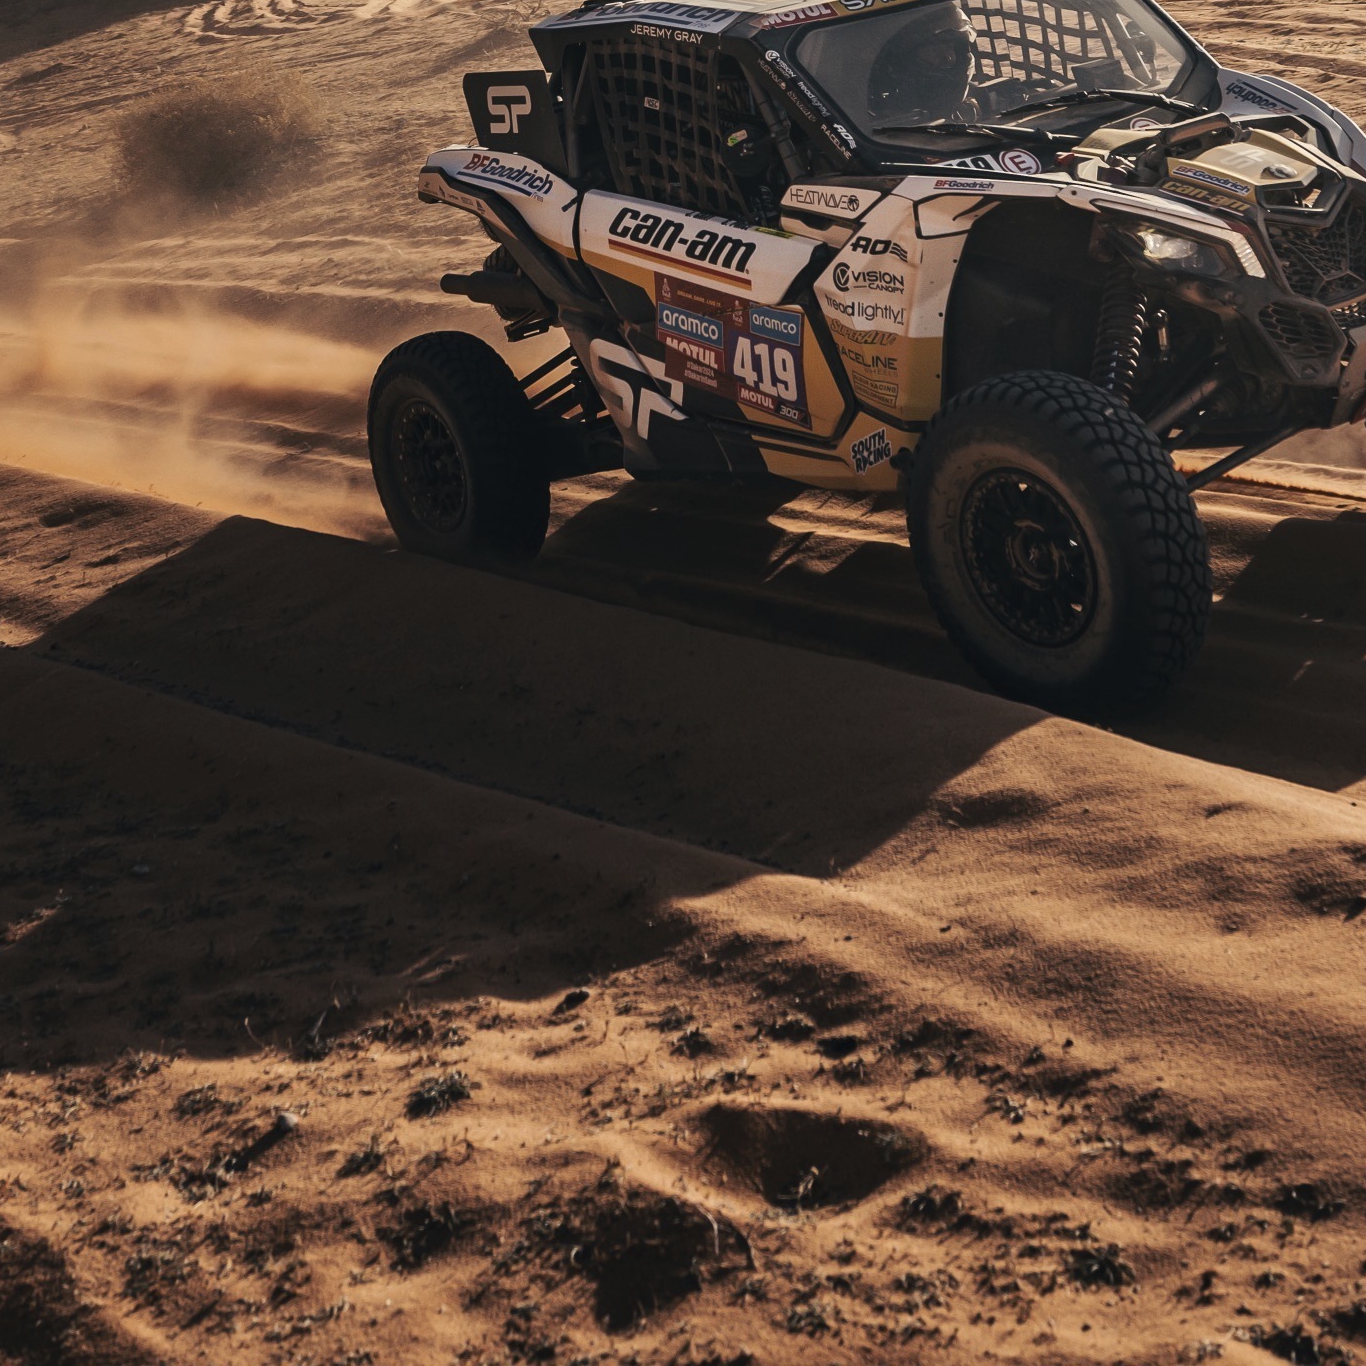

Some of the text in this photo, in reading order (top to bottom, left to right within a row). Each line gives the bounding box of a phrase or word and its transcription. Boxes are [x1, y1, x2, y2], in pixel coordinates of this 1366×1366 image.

[761, 3, 832, 26] MOTUL
[630, 24, 703, 44] JEREMY GRAY
[487, 85, 531, 133] SP
[821, 124, 852, 159] RACELINE
[463, 153, 553, 195] BFGoodrich
[935, 180, 994, 189] BFGoodrich
[1176, 165, 1251, 193] BFGoodrich
[790, 188, 848, 210] HEATWAVE
[1162, 181, 1251, 211] can-am
[608, 207, 757, 274] can-am
[851, 270, 904, 285] VISION
[868, 283, 904, 294] CANOPY
[662, 309, 718, 340] aramco
[752, 313, 797, 334] aramco
[733, 336, 797, 402] 419
[740, 388, 774, 409] MOTUL
[852, 429, 885, 459] SOUTH
